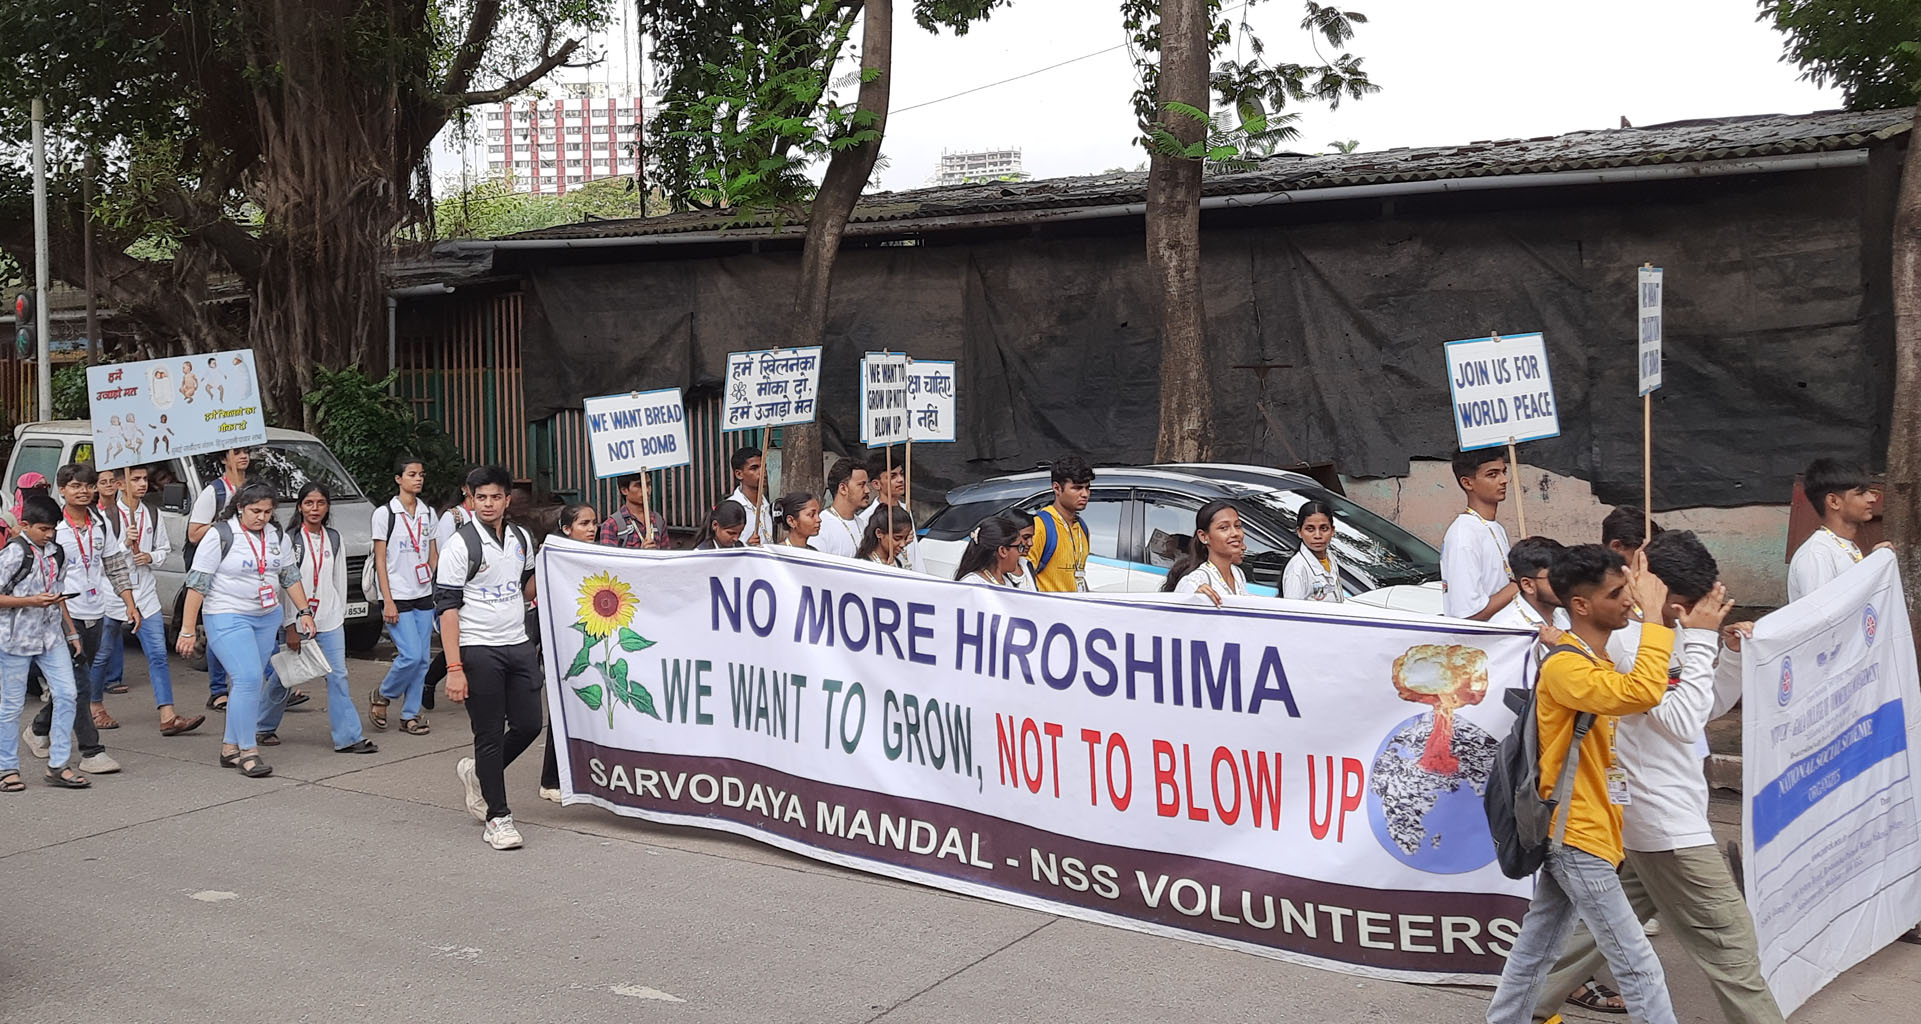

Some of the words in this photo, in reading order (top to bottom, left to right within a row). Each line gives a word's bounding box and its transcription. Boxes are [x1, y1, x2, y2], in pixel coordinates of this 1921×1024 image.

[732, 354, 754, 381] हमें
[869, 363, 880, 383] WE
[881, 363, 897, 383] WANT
[898, 363, 905, 382] TO
[1455, 360, 1490, 389] JOIN
[1492, 357, 1511, 385] US
[1513, 355, 1540, 381] FOR
[729, 397, 752, 424] हमें
[868, 390, 884, 410] GROW
[886, 390, 893, 409] UP
[1458, 398, 1508, 429] WORLD
[1513, 392, 1552, 421] PEACE
[588, 413, 608, 433] WE
[609, 408, 643, 430] WANT
[644, 404, 683, 426] BREAD
[874, 416, 891, 437] BLOW
[893, 416, 901, 435] UP
[607, 440, 635, 461] NOT
[640, 434, 677, 456] BOMB
[348, 607, 366, 615] 8534
[709, 576, 777, 637] NO
[794, 585, 937, 666] MORE
[955, 606, 1302, 718] HIROSHIMA
[661, 657, 713, 725] WE
[728, 662, 807, 743] WANT
[822, 678, 867, 755] TO
[883, 689, 983, 794] GROW,
[995, 712, 1063, 799] NOT
[1081, 728, 1133, 812] TO
[1152, 738, 1283, 832] BLOW
[1307, 754, 1365, 844] UP
[589, 757, 807, 829] SARVODAYA
[816, 800, 995, 871] MANDAL
[1030, 847, 1120, 900] NSS
[1134, 868, 1523, 959] VOLUNTEERS
